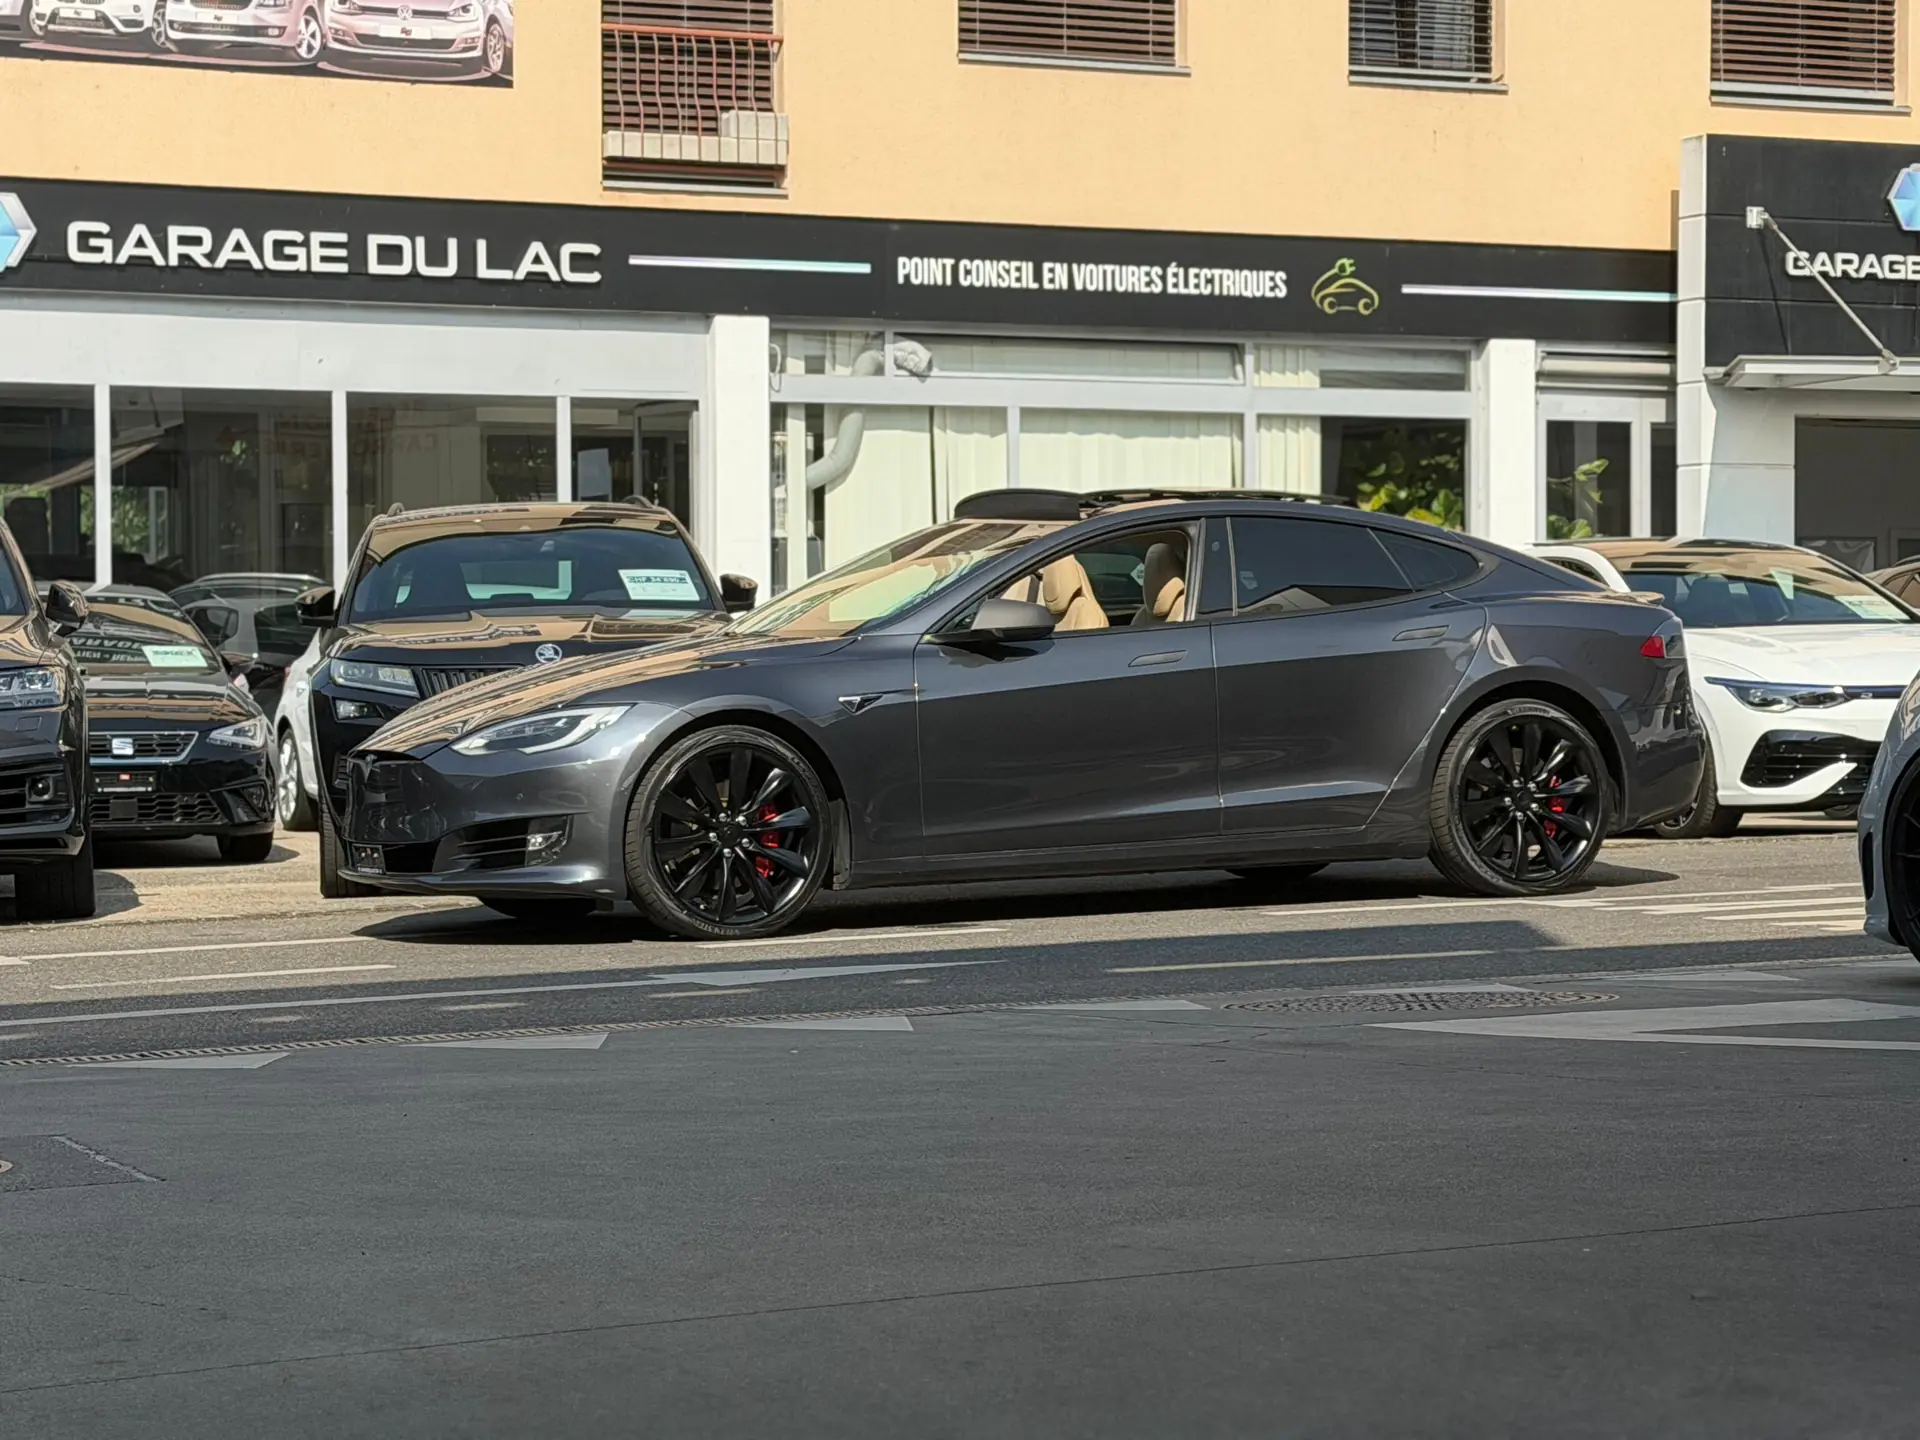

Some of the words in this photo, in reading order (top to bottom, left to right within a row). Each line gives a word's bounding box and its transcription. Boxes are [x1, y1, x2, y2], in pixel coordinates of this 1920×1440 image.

[66, 221, 349, 273] GARAGE
[366, 234, 458, 277] DU
[476, 239, 602, 283] LAC
[1785, 251, 1920, 280] GARAGE
[897, 256, 956, 287] POINT
[958, 258, 1040, 290] CONSEIL
[1042, 261, 1069, 291] EN
[1071, 262, 1163, 294] VOITURES
[1166, 261, 1288, 299] ÉLECTRIQUES
